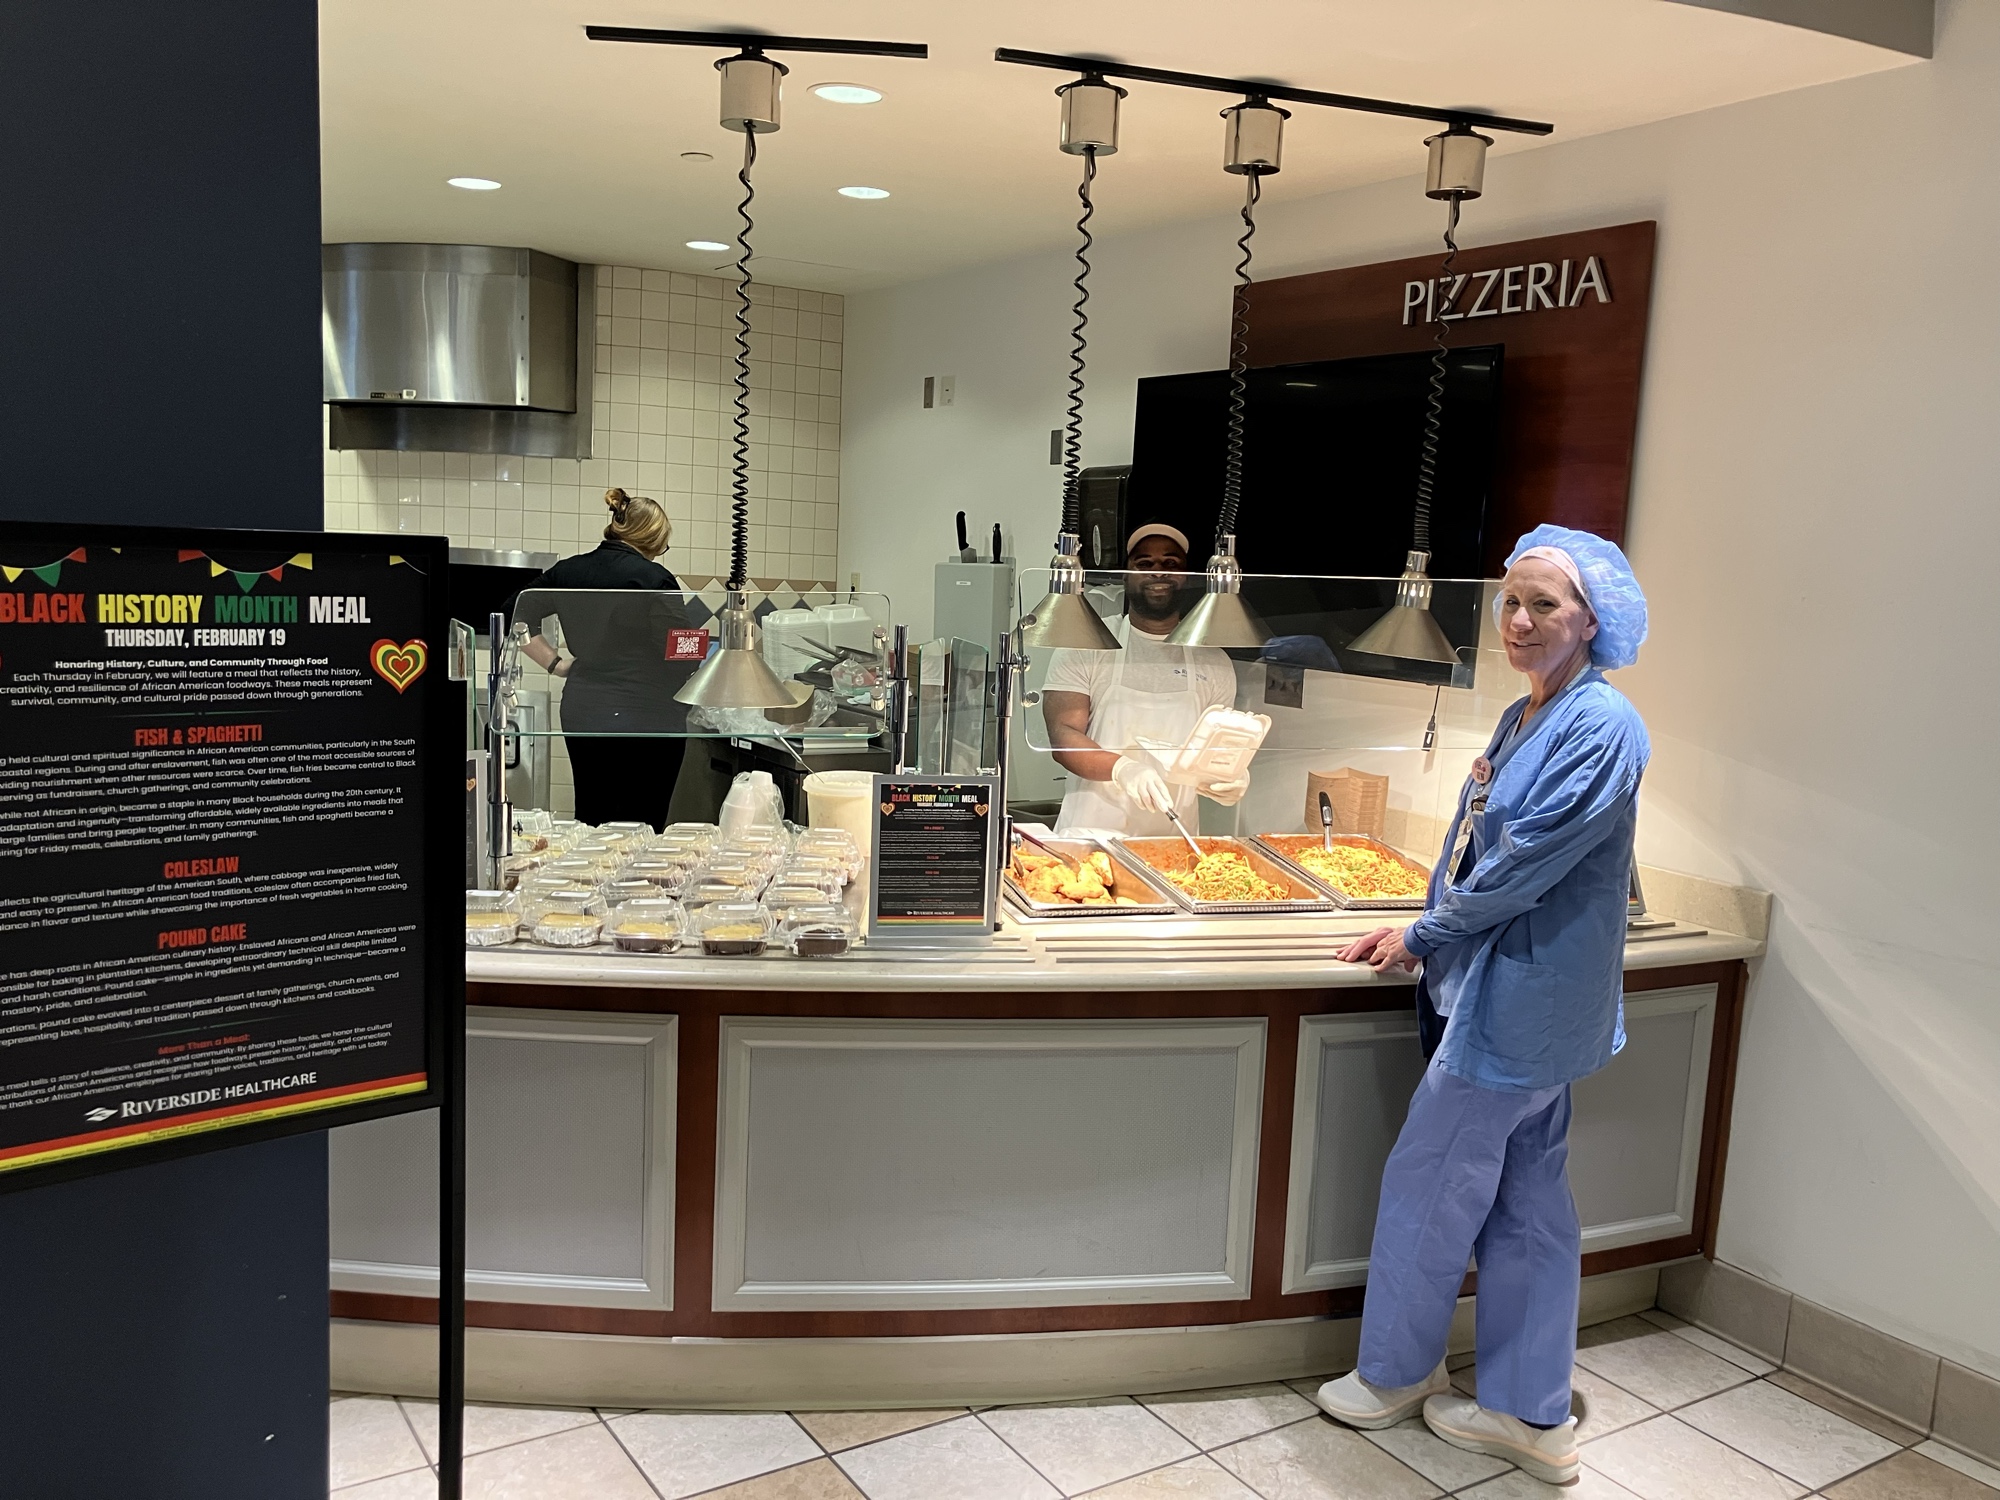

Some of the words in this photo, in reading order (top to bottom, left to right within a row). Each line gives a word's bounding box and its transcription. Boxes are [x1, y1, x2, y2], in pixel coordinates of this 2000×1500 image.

[1403, 256, 1611, 325] PIZZERIA
[0, 593, 86, 622] BLACK
[98, 594, 202, 623] HISTORY
[215, 595, 298, 623] MONTH
[310, 596, 370, 623] MEAL
[105, 629, 189, 648] THURSDAY,
[194, 629, 265, 646] FEBRUARY
[270, 629, 285, 645] 19
[14, 673, 40, 682] Each
[42, 672, 92, 682] Thursday
[94, 670, 104, 680] in
[106, 672, 153, 681] February,
[171, 670, 187, 678] will
[189, 670, 224, 678] feature
[234, 669, 258, 677] meal
[260, 669, 278, 677] that
[280, 668, 313, 676] reflects
[314, 668, 329, 676] the
[330, 668, 362, 677] history,
[55, 660, 104, 670] Honoring
[106, 660, 146, 670] History,
[147, 660, 187, 668] Culture,
[188, 659, 208, 667] and
[209, 658, 266, 668] Community
[267, 658, 305, 667] Through
[306, 657, 328, 665] Food
[0, 685, 52, 695] creativity,
[54, 684, 76, 693] and
[78, 684, 127, 692] resilience
[128, 683, 139, 691] of
[141, 682, 176, 690] African
[178, 682, 224, 690] American
[226, 680, 273, 690] foodways.
[275, 680, 301, 688] These
[303, 679, 330, 687] meals
[332, 678, 372, 688] represent
[11, 697, 55, 706] survival,
[57, 696, 119, 705] community,
[121, 694, 142, 703] and
[144, 693, 181, 702] cultural
[183, 693, 208, 703] pride
[210, 692, 244, 702] passed
[246, 692, 272, 700] down
[274, 690, 309, 700] through
[310, 690, 363, 700] generations.
[136, 728, 168, 746] FISH
[173, 730, 182, 744] &
[188, 725, 262, 744] SPAGHETTI
[8, 756, 30, 764] held
[32, 754, 70, 763] cultural
[71, 753, 90, 761] and
[92, 751, 130, 762] spiritual
[131, 750, 186, 760] significance
[270, 743, 324, 752] communities,
[326, 740, 370, 750] particularly
[393, 738, 416, 746] South
[34, 767, 72, 777] regions.
[74, 765, 106, 774] During
[107, 763, 126, 771] and
[128, 762, 150, 770] after
[151, 759, 210, 769] enslavement,
[247, 756, 269, 764] often
[287, 754, 296, 762] of
[334, 751, 375, 760] accessible
[376, 750, 406, 758] sources
[407, 748, 415, 756] of
[31, 777, 92, 787] nourishment
[94, 776, 120, 784] when
[121, 774, 146, 782] other
[147, 772, 191, 781] resources
[306, 764, 322, 772] fries
[358, 761, 386, 769] central
[24, 810, 40, 818] not
[42, 808, 77, 816] African
[89, 806, 118, 815] origin,
[119, 803, 158, 812] became
[167, 800, 195, 809] staple
[206, 798, 231, 806] many
[232, 796, 254, 804] Black
[256, 793, 303, 802] households
[304, 792, 330, 800] during
[364, 788, 395, 796] century.
[892, 794, 910, 802] BLACK
[913, 794, 937, 803] HISTORY
[938, 795, 960, 803] MONTH
[962, 795, 978, 803] MEAL
[164, 856, 240, 879] COLESLAW
[32, 896, 49, 904] the
[50, 890, 105, 903] agricultural
[106, 887, 145, 896] heritage
[146, 884, 156, 892] of
[174, 880, 216, 889] American
[216, 876, 243, 885] South,
[270, 871, 308, 880] cabbage
[326, 866, 372, 875] inexpensive,
[374, 862, 398, 870] widely
[158, 928, 207, 949] POUND
[211, 924, 247, 942] CAKE
[29, 968, 55, 977] deep
[56, 965, 81, 973] roots
[93, 959, 126, 968] African
[127, 953, 171, 964] American
[172, 949, 207, 958] culinary
[239, 940, 276, 950] Enslaved
[276, 937, 309, 946] Africans
[310, 934, 326, 942] and
[327, 932, 355, 940] African
[356, 927, 397, 936] Americans
[158, 1045, 185, 1055] More
[187, 1040, 213, 1051] Than
[121, 1088, 221, 1118] RIVERSIDE
[226, 1072, 317, 1098] HEALTHCARE
